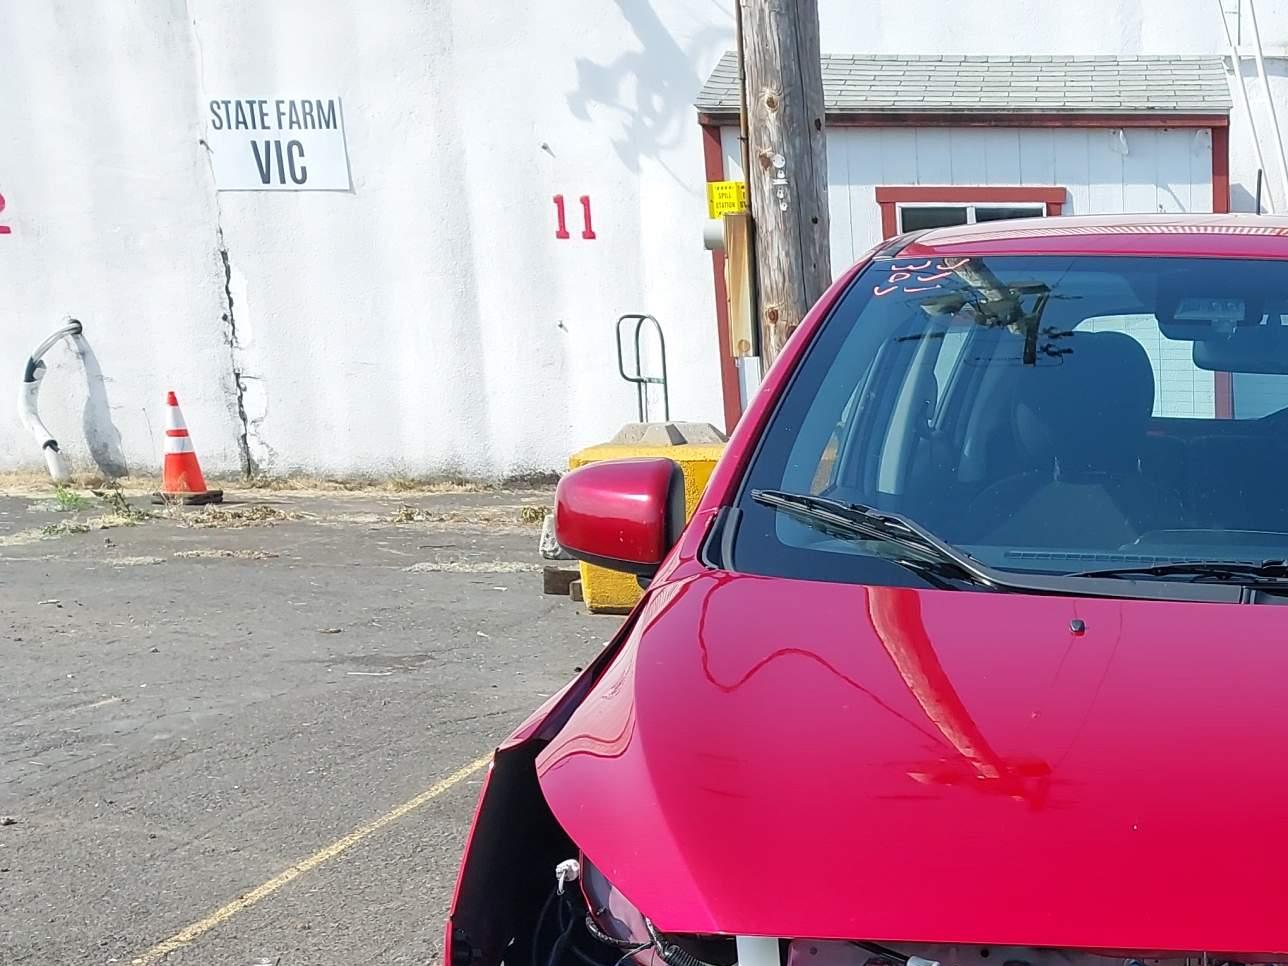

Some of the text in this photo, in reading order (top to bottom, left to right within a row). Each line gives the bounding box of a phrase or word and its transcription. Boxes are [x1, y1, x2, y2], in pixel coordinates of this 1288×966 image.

[209, 100, 338, 130] STATE FARM
[250, 140, 307, 185] VIC
[554, 194, 597, 241] 11
